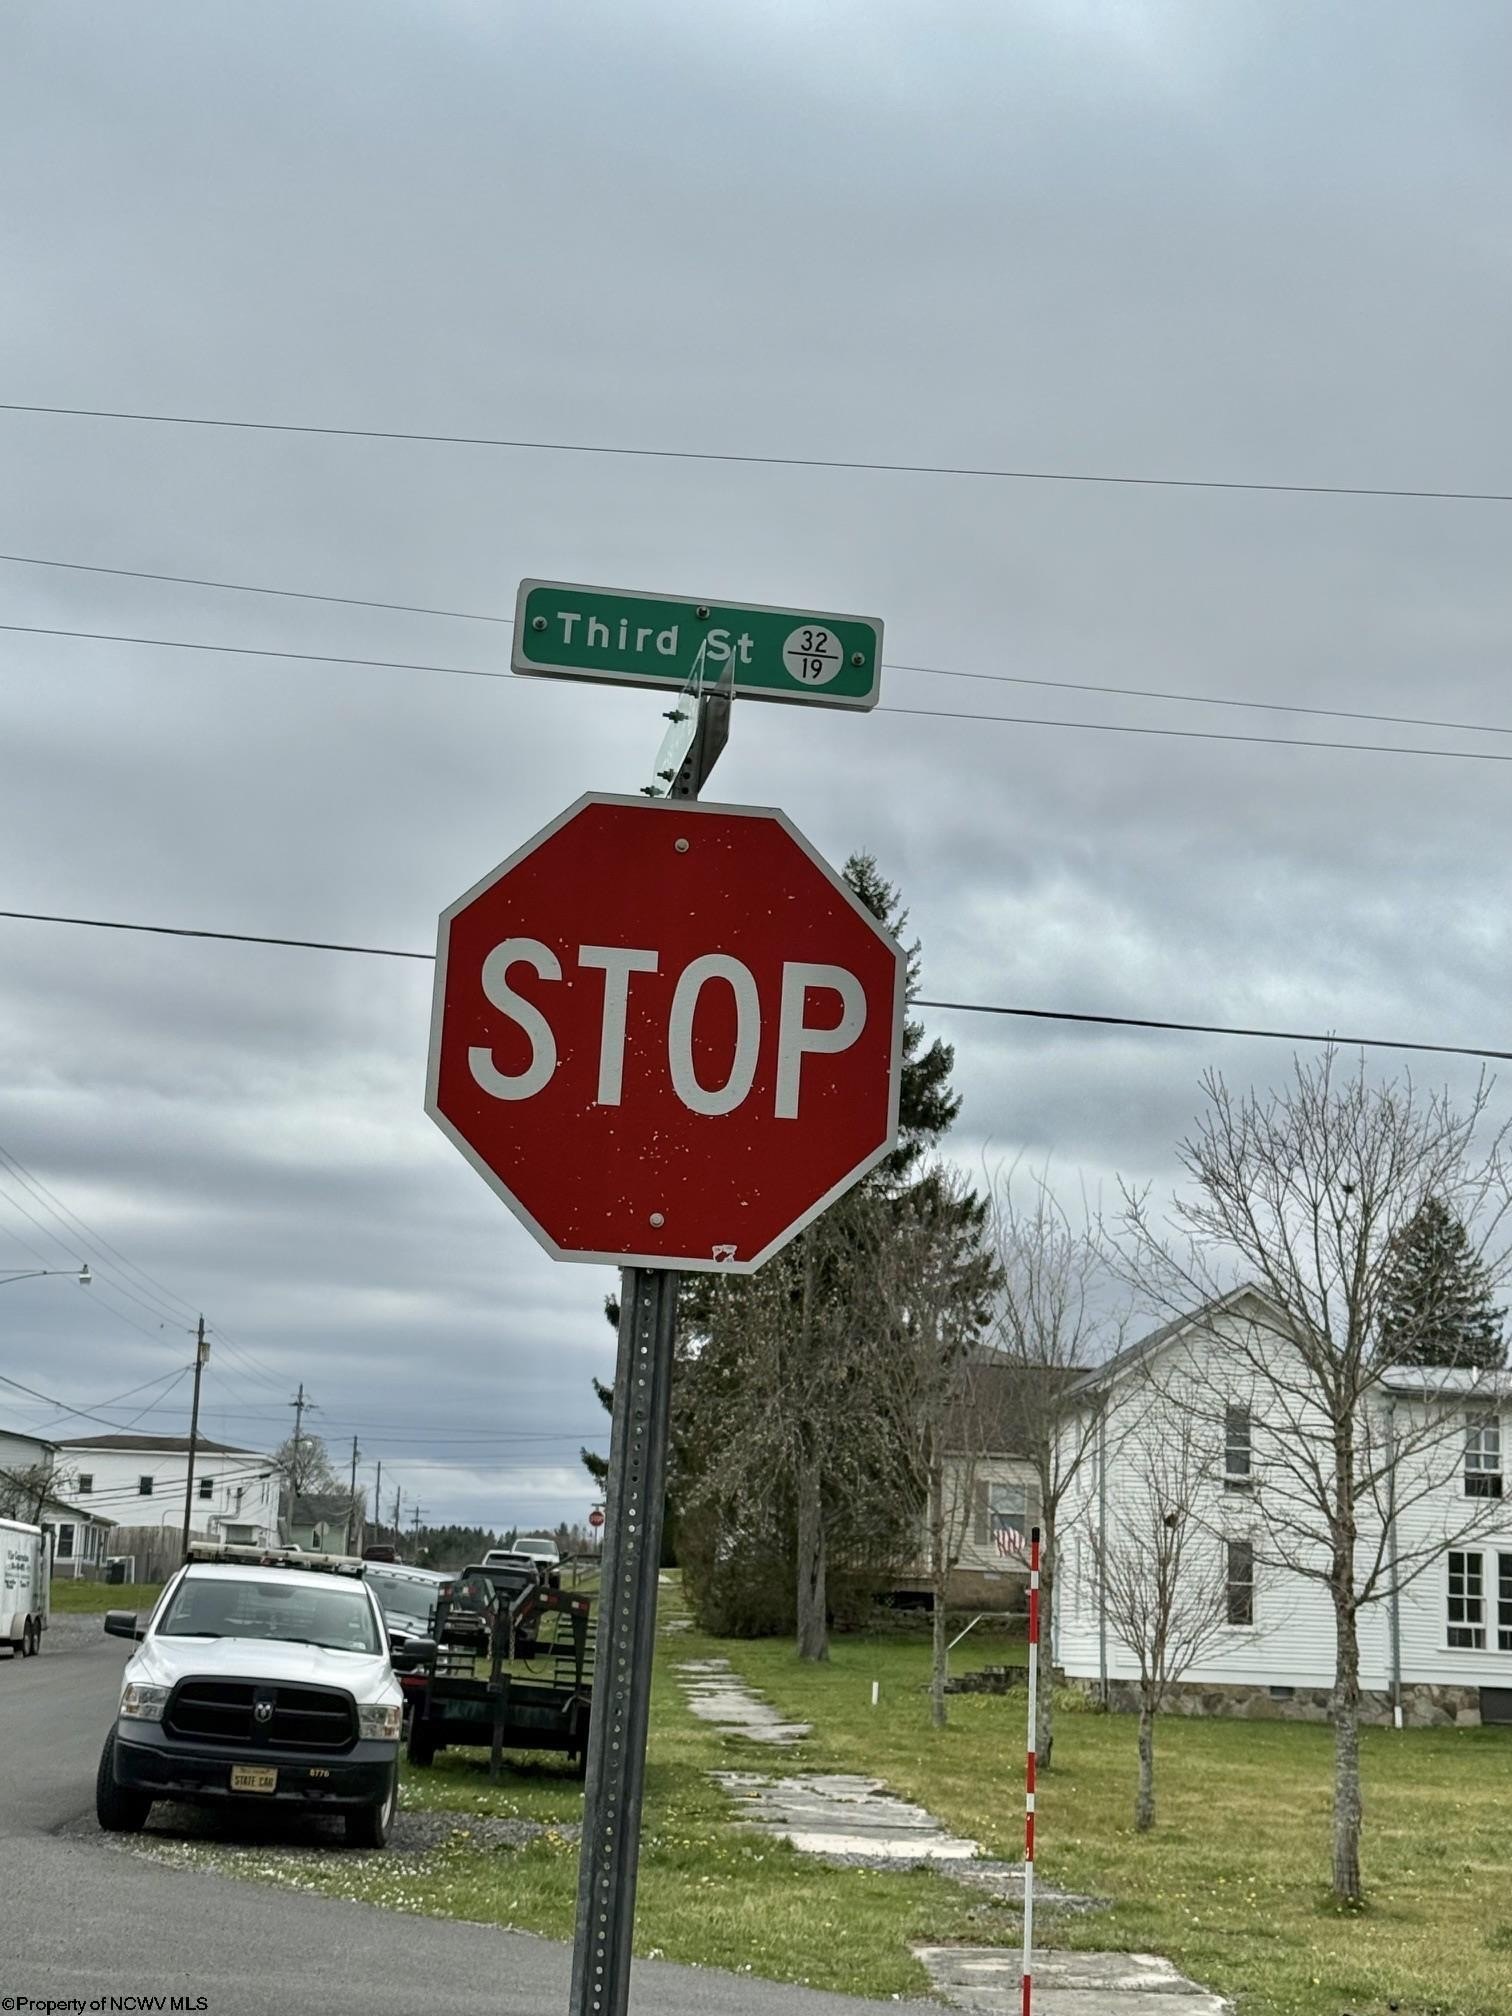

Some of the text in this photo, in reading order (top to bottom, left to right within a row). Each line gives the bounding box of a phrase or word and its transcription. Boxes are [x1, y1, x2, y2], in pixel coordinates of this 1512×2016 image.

[557, 612, 754, 664] Third St
[800, 630, 828, 654] 32
[801, 657, 823, 679] 19
[468, 937, 867, 1120] STOP
[234, 1775, 257, 1787] STATE
